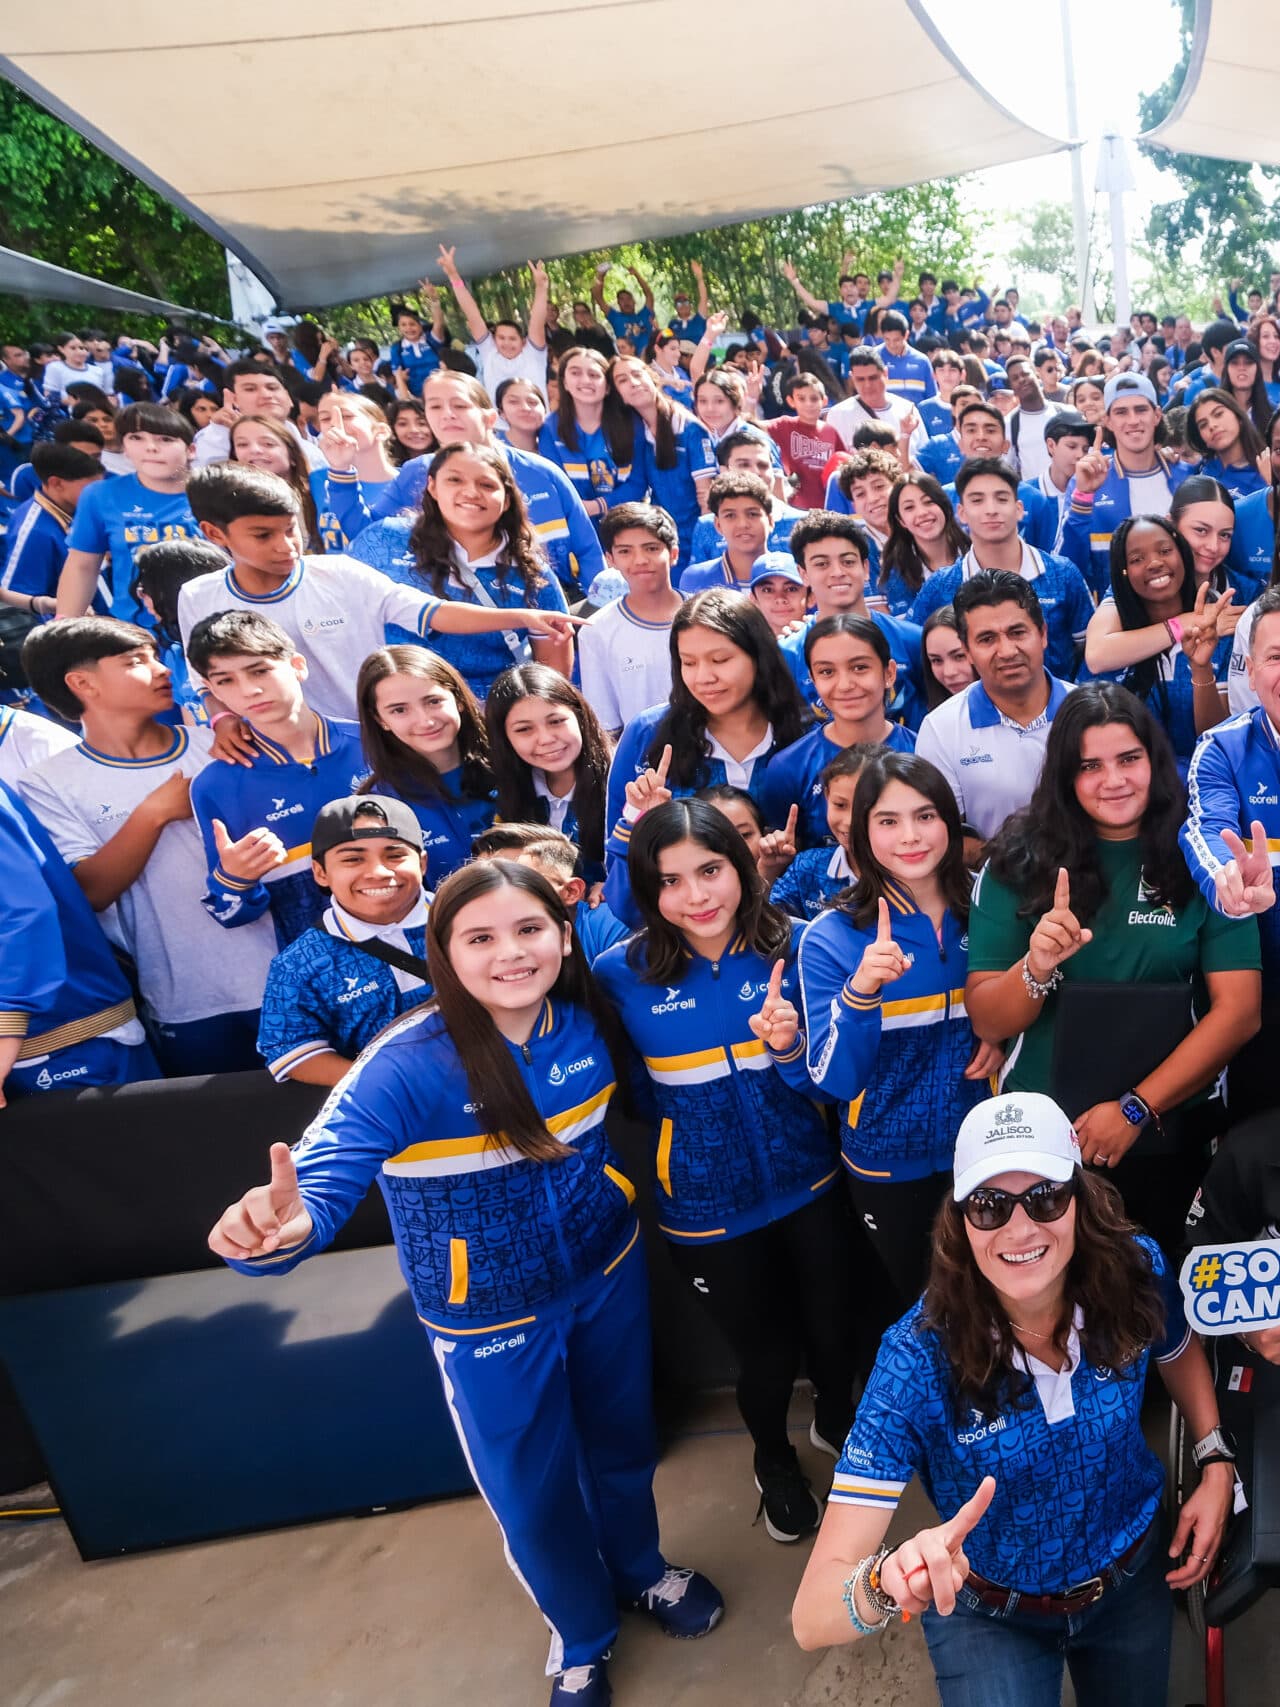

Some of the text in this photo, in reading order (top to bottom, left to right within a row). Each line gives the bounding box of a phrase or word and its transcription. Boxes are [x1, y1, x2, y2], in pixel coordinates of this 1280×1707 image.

[320, 617, 345, 628] CODE
[1249, 795, 1278, 805] sporelli
[266, 804, 304, 821] sporelli
[1129, 911, 1177, 927] Electrolit
[338, 981, 379, 1003] sporelli
[652, 998, 696, 1015] sporelli
[54, 1066, 88, 1081] CODE
[569, 1056, 595, 1075] CODE
[986, 1126, 1032, 1139] JALISCO
[474, 1333, 526, 1358] sporelli
[958, 1416, 1007, 1445] sporelli
